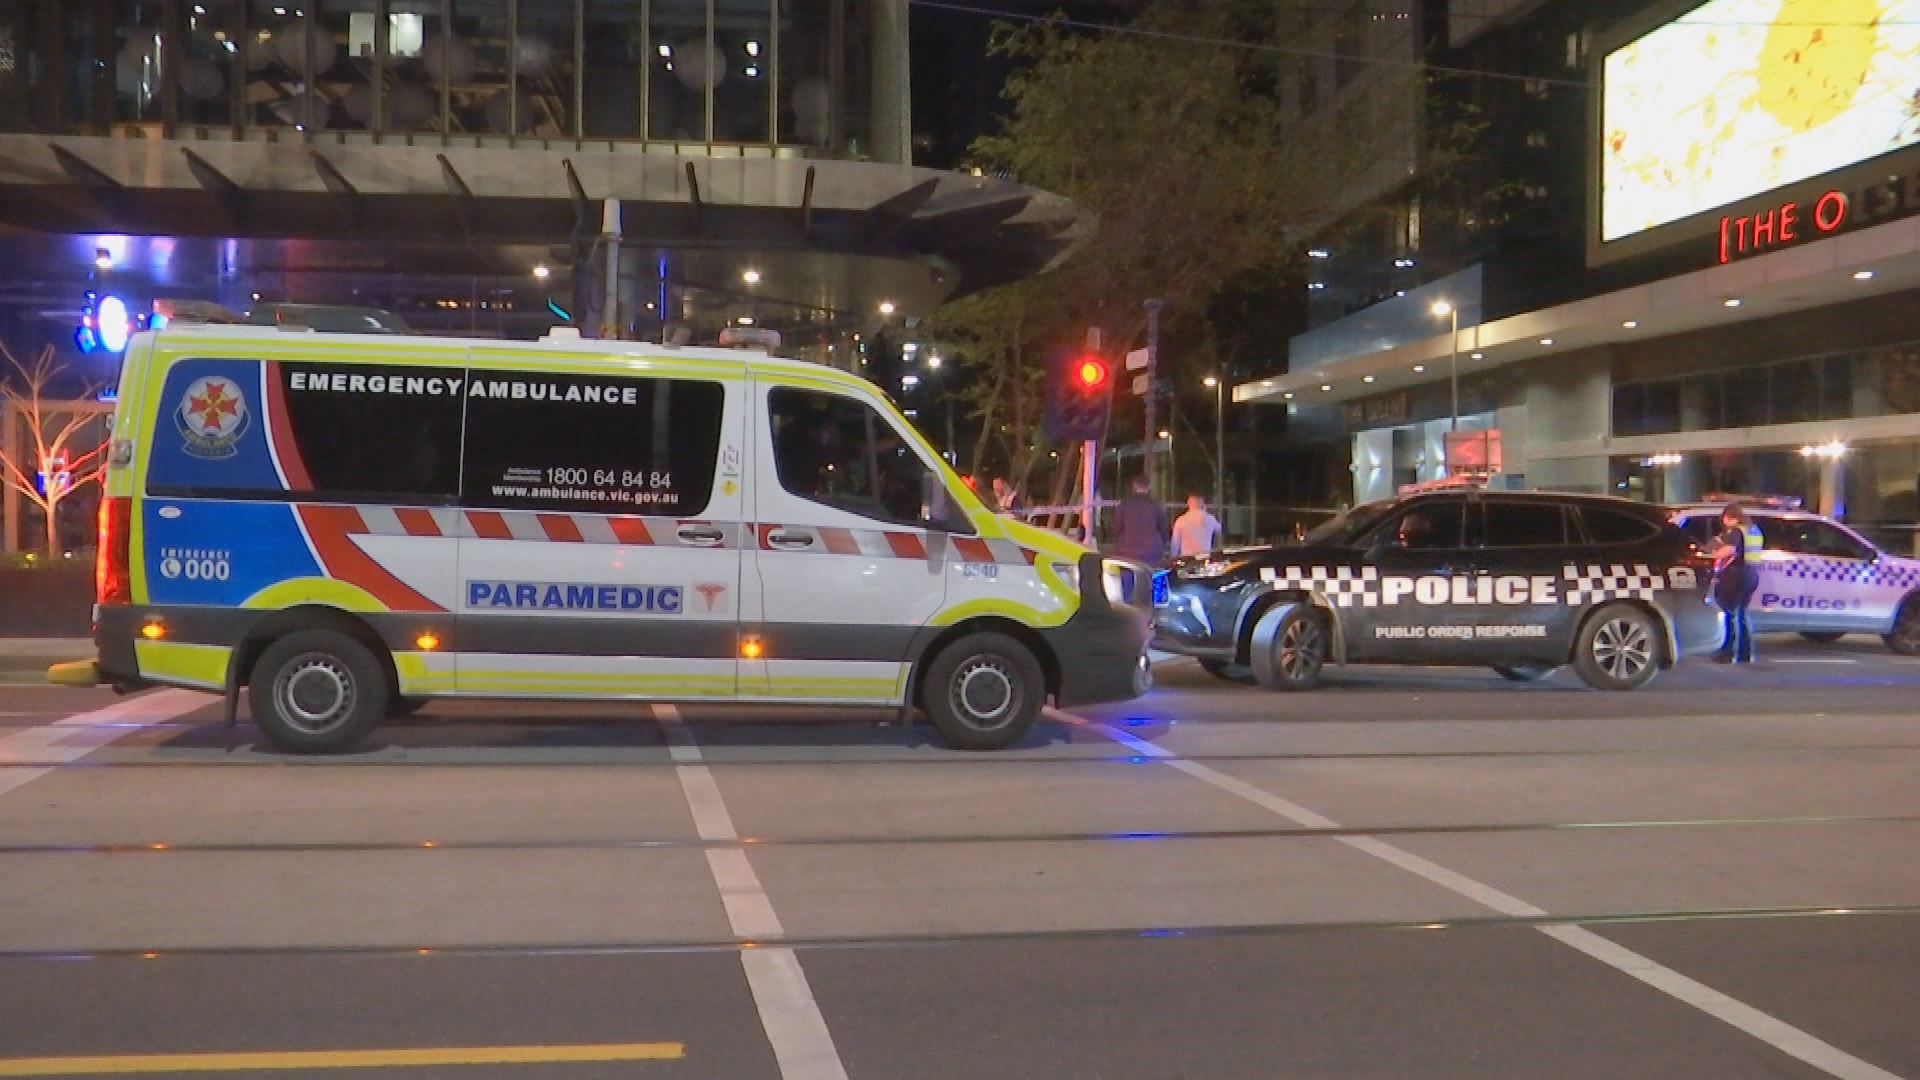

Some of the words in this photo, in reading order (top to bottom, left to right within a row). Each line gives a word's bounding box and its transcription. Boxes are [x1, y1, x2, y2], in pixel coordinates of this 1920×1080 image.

[290, 372, 461, 396] EMERGENCY
[469, 379, 637, 404] AMBULANCE
[546, 468, 587, 485] 1800
[594, 470, 615, 487] 64
[621, 470, 643, 487] 84
[650, 471, 671, 489] 84
[492, 485, 679, 504] www.ambulance.vic.gov.au
[184, 559, 230, 581] 000
[470, 583, 679, 611] PARAMEDIC
[1382, 575, 1558, 605] POLICE
[1761, 593, 1847, 610] Police
[1375, 626, 1426, 639] PUBLIC
[1427, 626, 1473, 640] ORDER
[1475, 625, 1547, 638] RESPONSE
